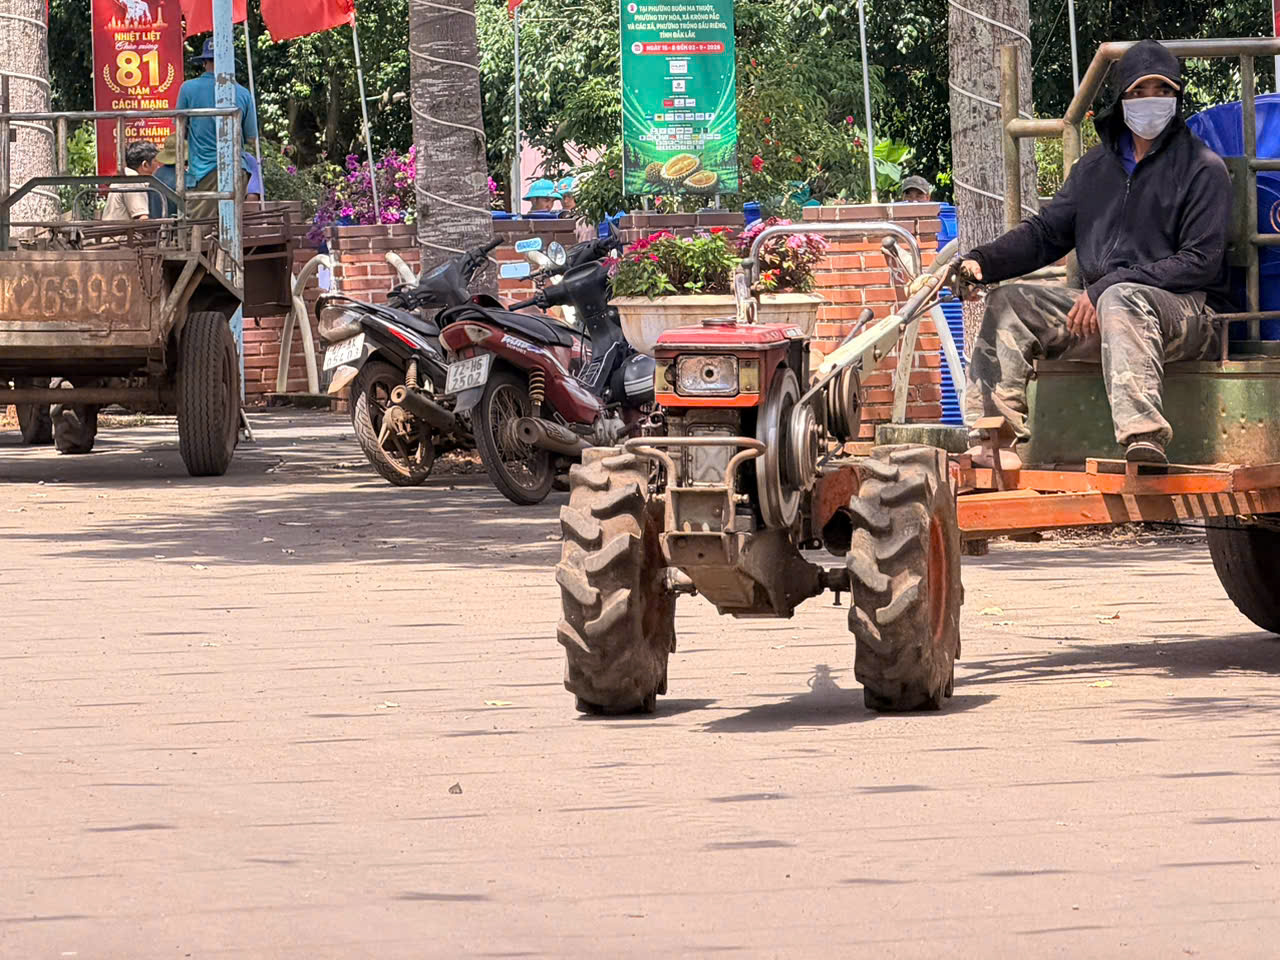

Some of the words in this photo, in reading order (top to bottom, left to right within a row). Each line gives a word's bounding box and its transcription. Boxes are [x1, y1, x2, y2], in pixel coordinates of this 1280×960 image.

[114, 30, 141, 42] NHIỆT
[142, 29, 162, 42] LIỆT
[116, 50, 160, 87] 81
[127, 86, 150, 95] NĂM
[111, 98, 138, 110] CÁCH
[141, 99, 169, 111] MẠNG
[140, 125, 170, 137] KHÁNH
[452, 371, 481, 391] 2502
